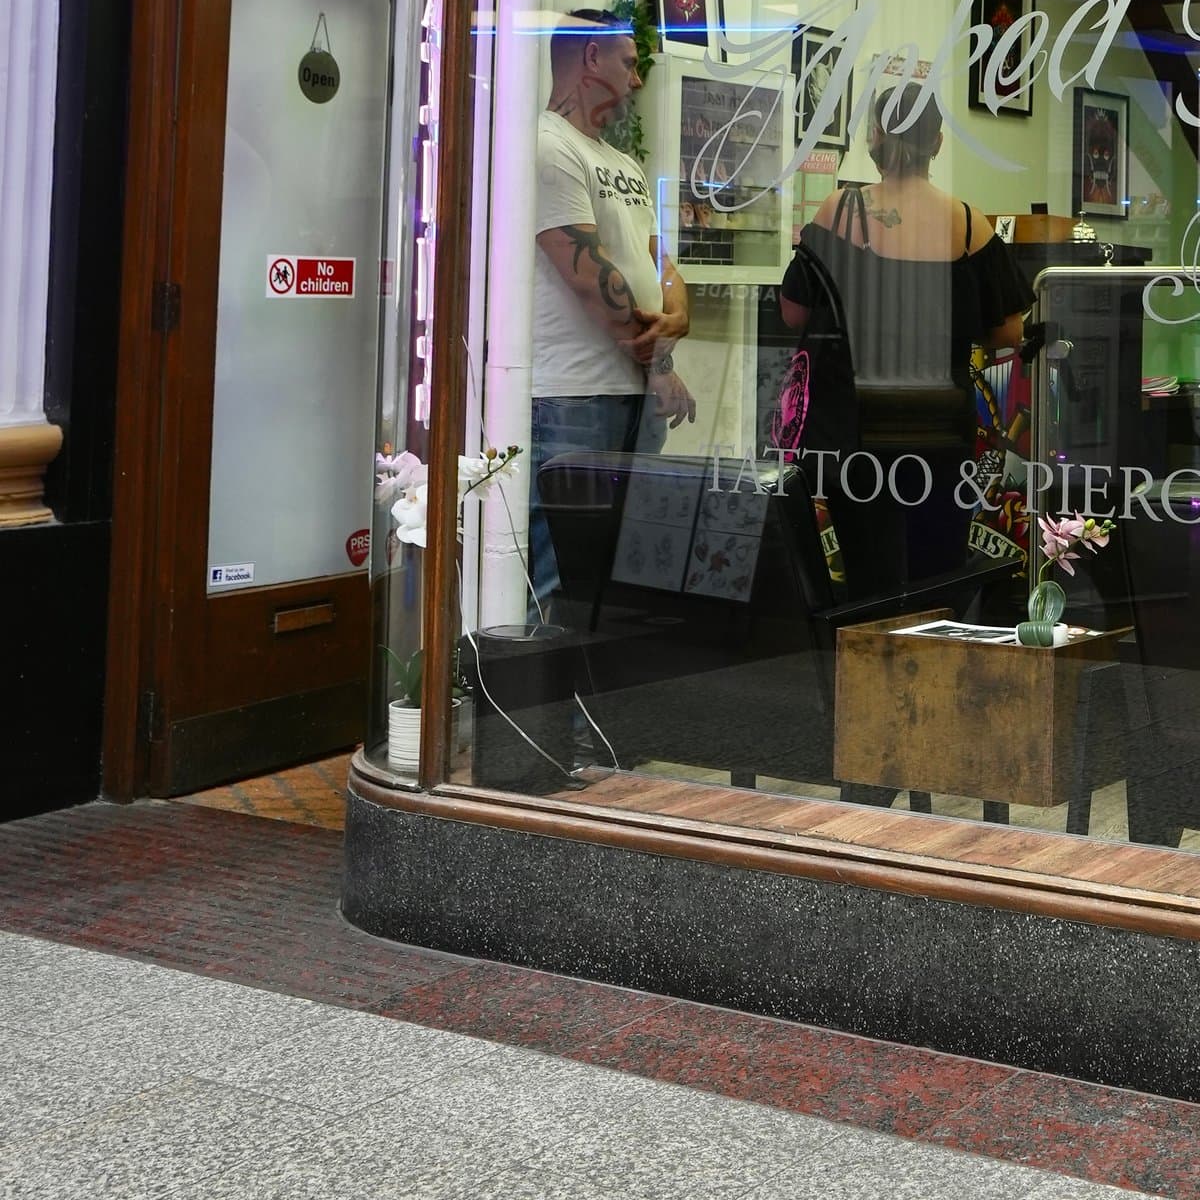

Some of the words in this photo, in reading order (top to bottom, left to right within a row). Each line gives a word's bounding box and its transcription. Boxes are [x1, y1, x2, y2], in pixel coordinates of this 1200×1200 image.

[303, 66, 335, 87] Open
[317, 262, 335, 276] No
[300, 277, 350, 293] children
[701, 440, 932, 506] TATTOO
[954, 458, 1003, 512] &
[350, 534, 371, 550] PRS
